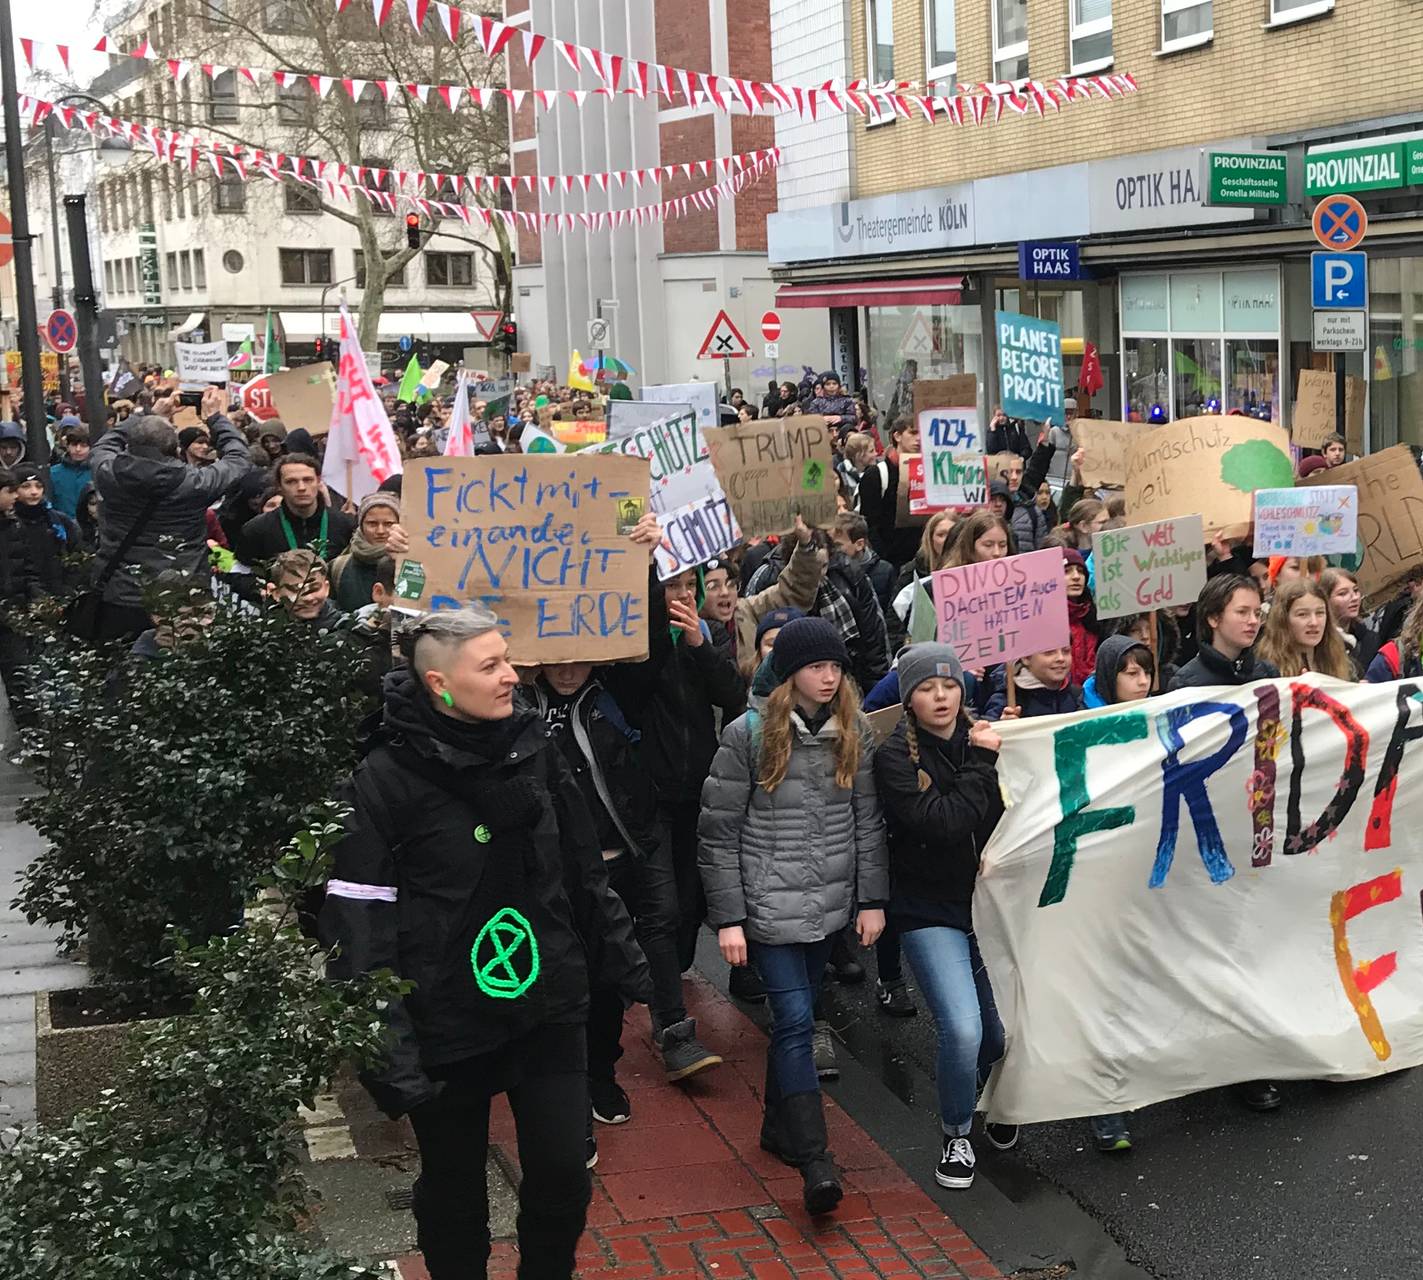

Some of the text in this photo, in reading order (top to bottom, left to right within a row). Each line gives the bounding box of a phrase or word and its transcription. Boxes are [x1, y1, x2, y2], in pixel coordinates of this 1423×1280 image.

[1214, 156, 1284, 170] PROVINZIAL
[1306, 152, 1400, 189] PROVINZIAL
[1116, 169, 1200, 210] OPTIK HA
[1220, 188, 1279, 199] Ornella Militello
[1221, 177, 1278, 188] Geschäftsstelle
[857, 198, 967, 244] Theatergemeinde KÖLN
[1032, 248, 1069, 260] OPTIK
[1033, 261, 1070, 274] HAAS
[1325, 259, 1353, 301] P
[1322, 327, 1355, 335] Parkschein
[1340, 315, 1350, 323] mit
[1000, 323, 1057, 354] PLANET
[1316, 338, 1342, 347] werktags
[1001, 348, 1059, 382] BEFORE
[250, 387, 273, 409] ST
[1003, 373, 1061, 408] PROFIT
[620, 411, 711, 481] CHUTZ
[729, 426, 823, 466] TRUMP
[1124, 421, 1233, 483] Klimaschutz
[424, 466, 528, 520] Fickt
[1100, 522, 1176, 558] Die Welt
[457, 543, 627, 591] NICHT
[940, 559, 1027, 599] DINOS
[1102, 557, 1124, 583] ist
[943, 578, 1058, 622] DACHTEN AUCH
[1098, 573, 1174, 611] als Geld
[537, 591, 644, 639] ERDE
